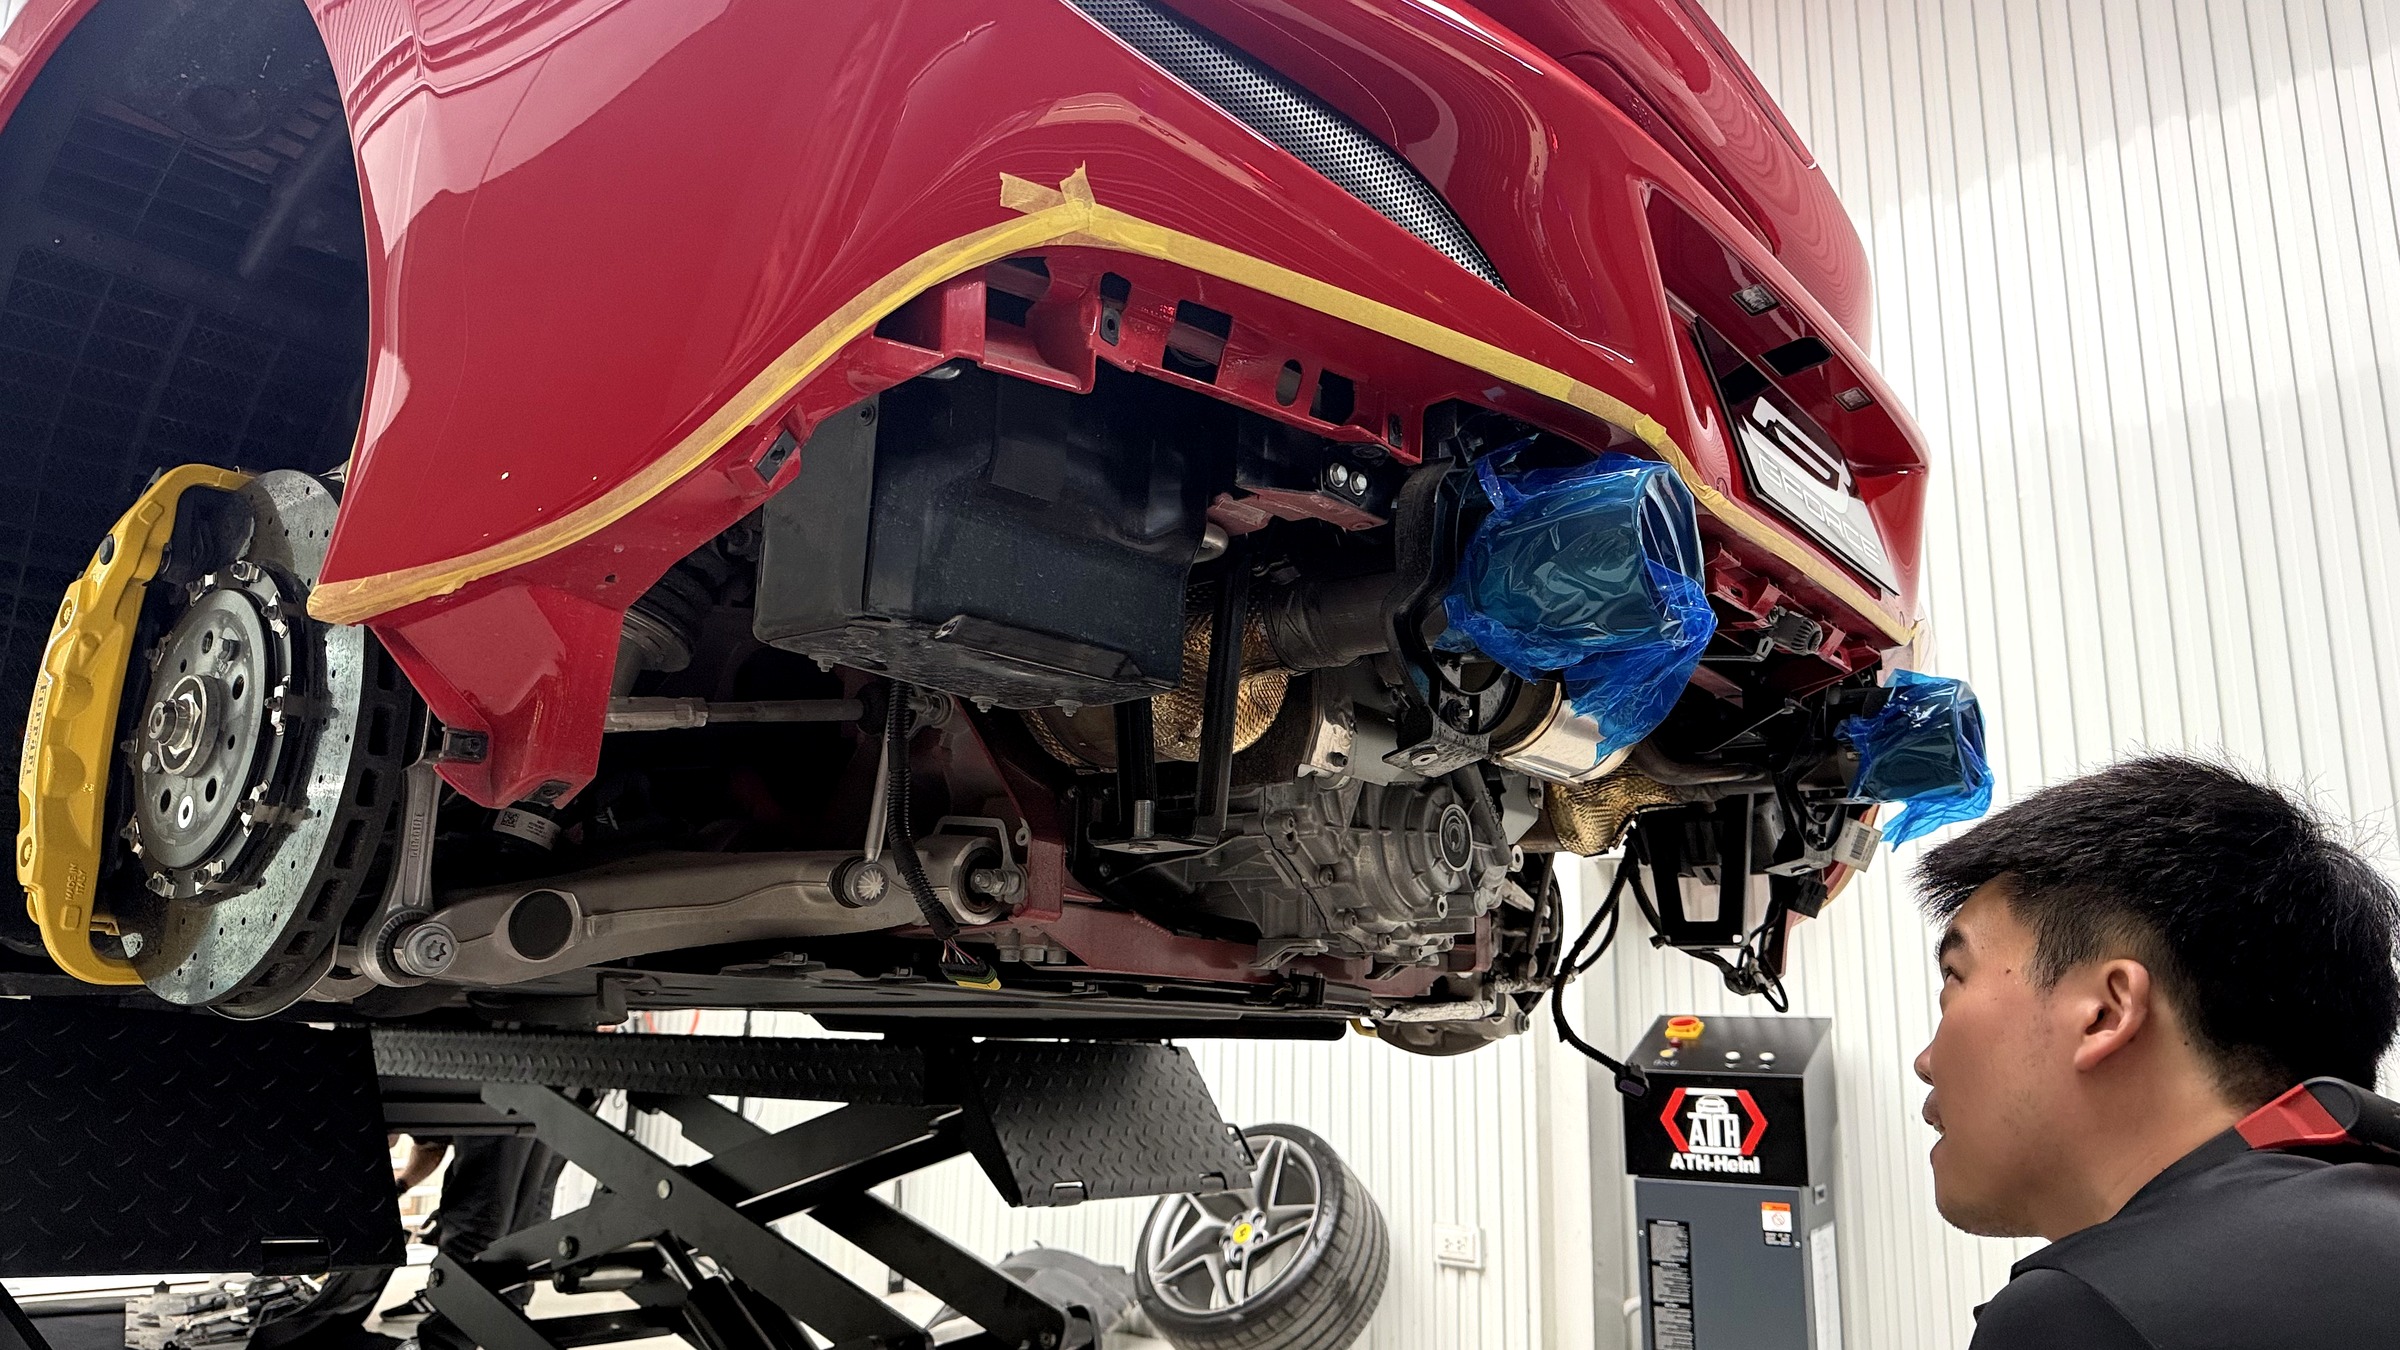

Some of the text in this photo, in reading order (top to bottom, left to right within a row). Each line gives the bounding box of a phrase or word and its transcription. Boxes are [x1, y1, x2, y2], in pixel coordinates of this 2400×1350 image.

[1759, 453, 1881, 566] GFORCE
[65, 863, 79, 900] MADE IN
[75, 869, 87, 895] ITALY
[1687, 1112, 1741, 1149] ATH
